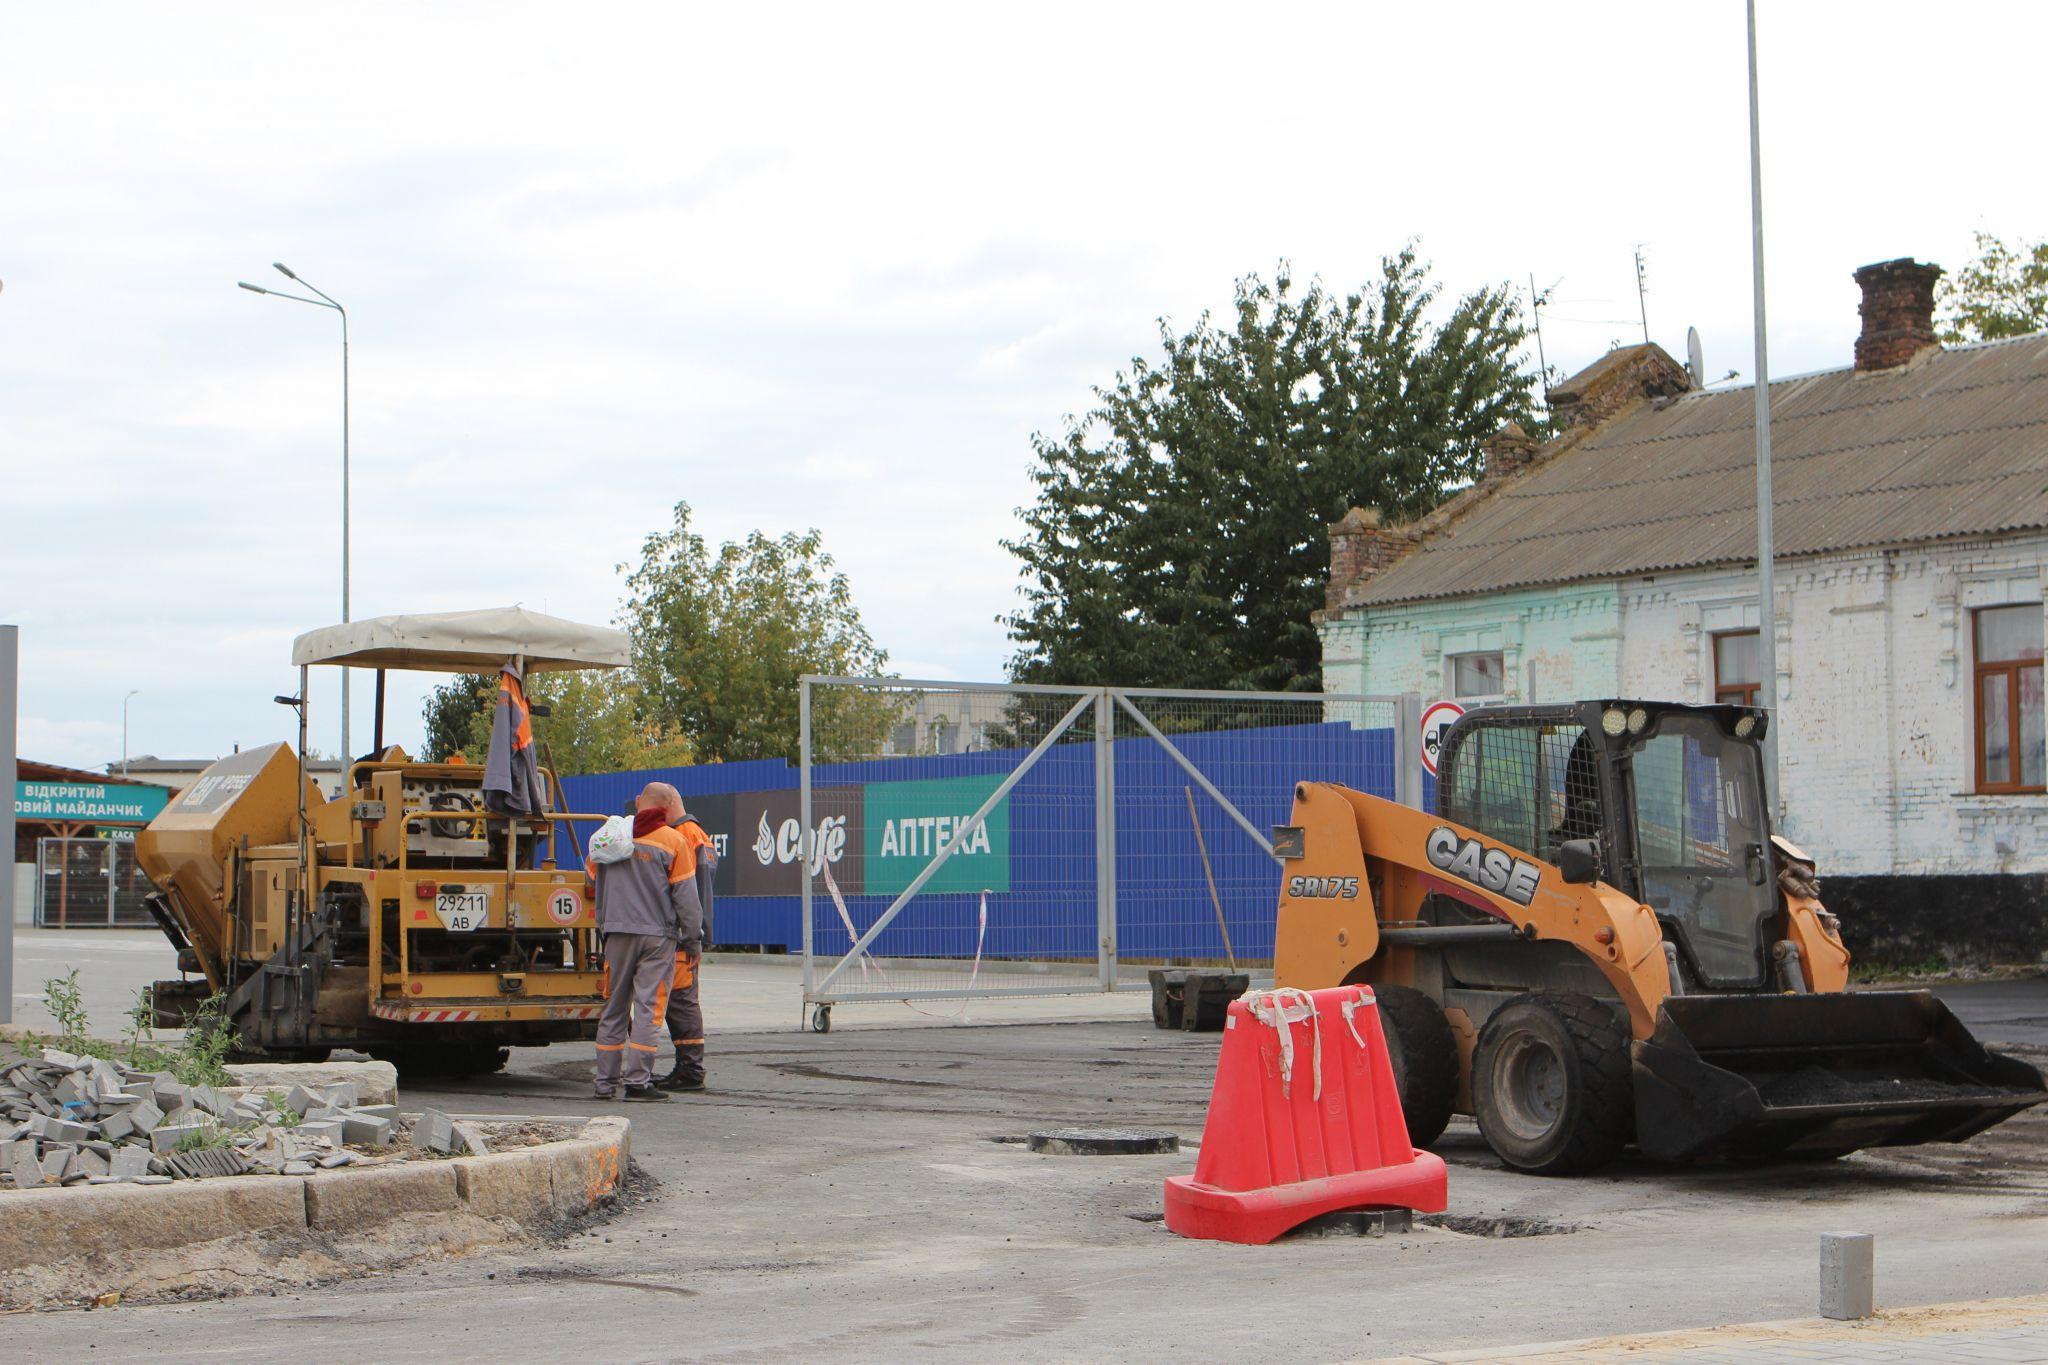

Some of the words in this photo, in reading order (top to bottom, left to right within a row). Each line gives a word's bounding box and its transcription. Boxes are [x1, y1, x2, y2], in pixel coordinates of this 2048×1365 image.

[25, 785, 105, 798] ВІДКРИТИЙ
[183, 775, 225, 806] CAT
[56, 801, 143, 816] МАЙДАНЧИК
[112, 830, 135, 841] КАСА
[881, 815, 991, 857] АПТЕКА
[1427, 827, 1541, 905] CASE
[1288, 876, 1359, 899] SR175
[438, 895, 485, 911] 29211
[555, 898, 573, 915] 15
